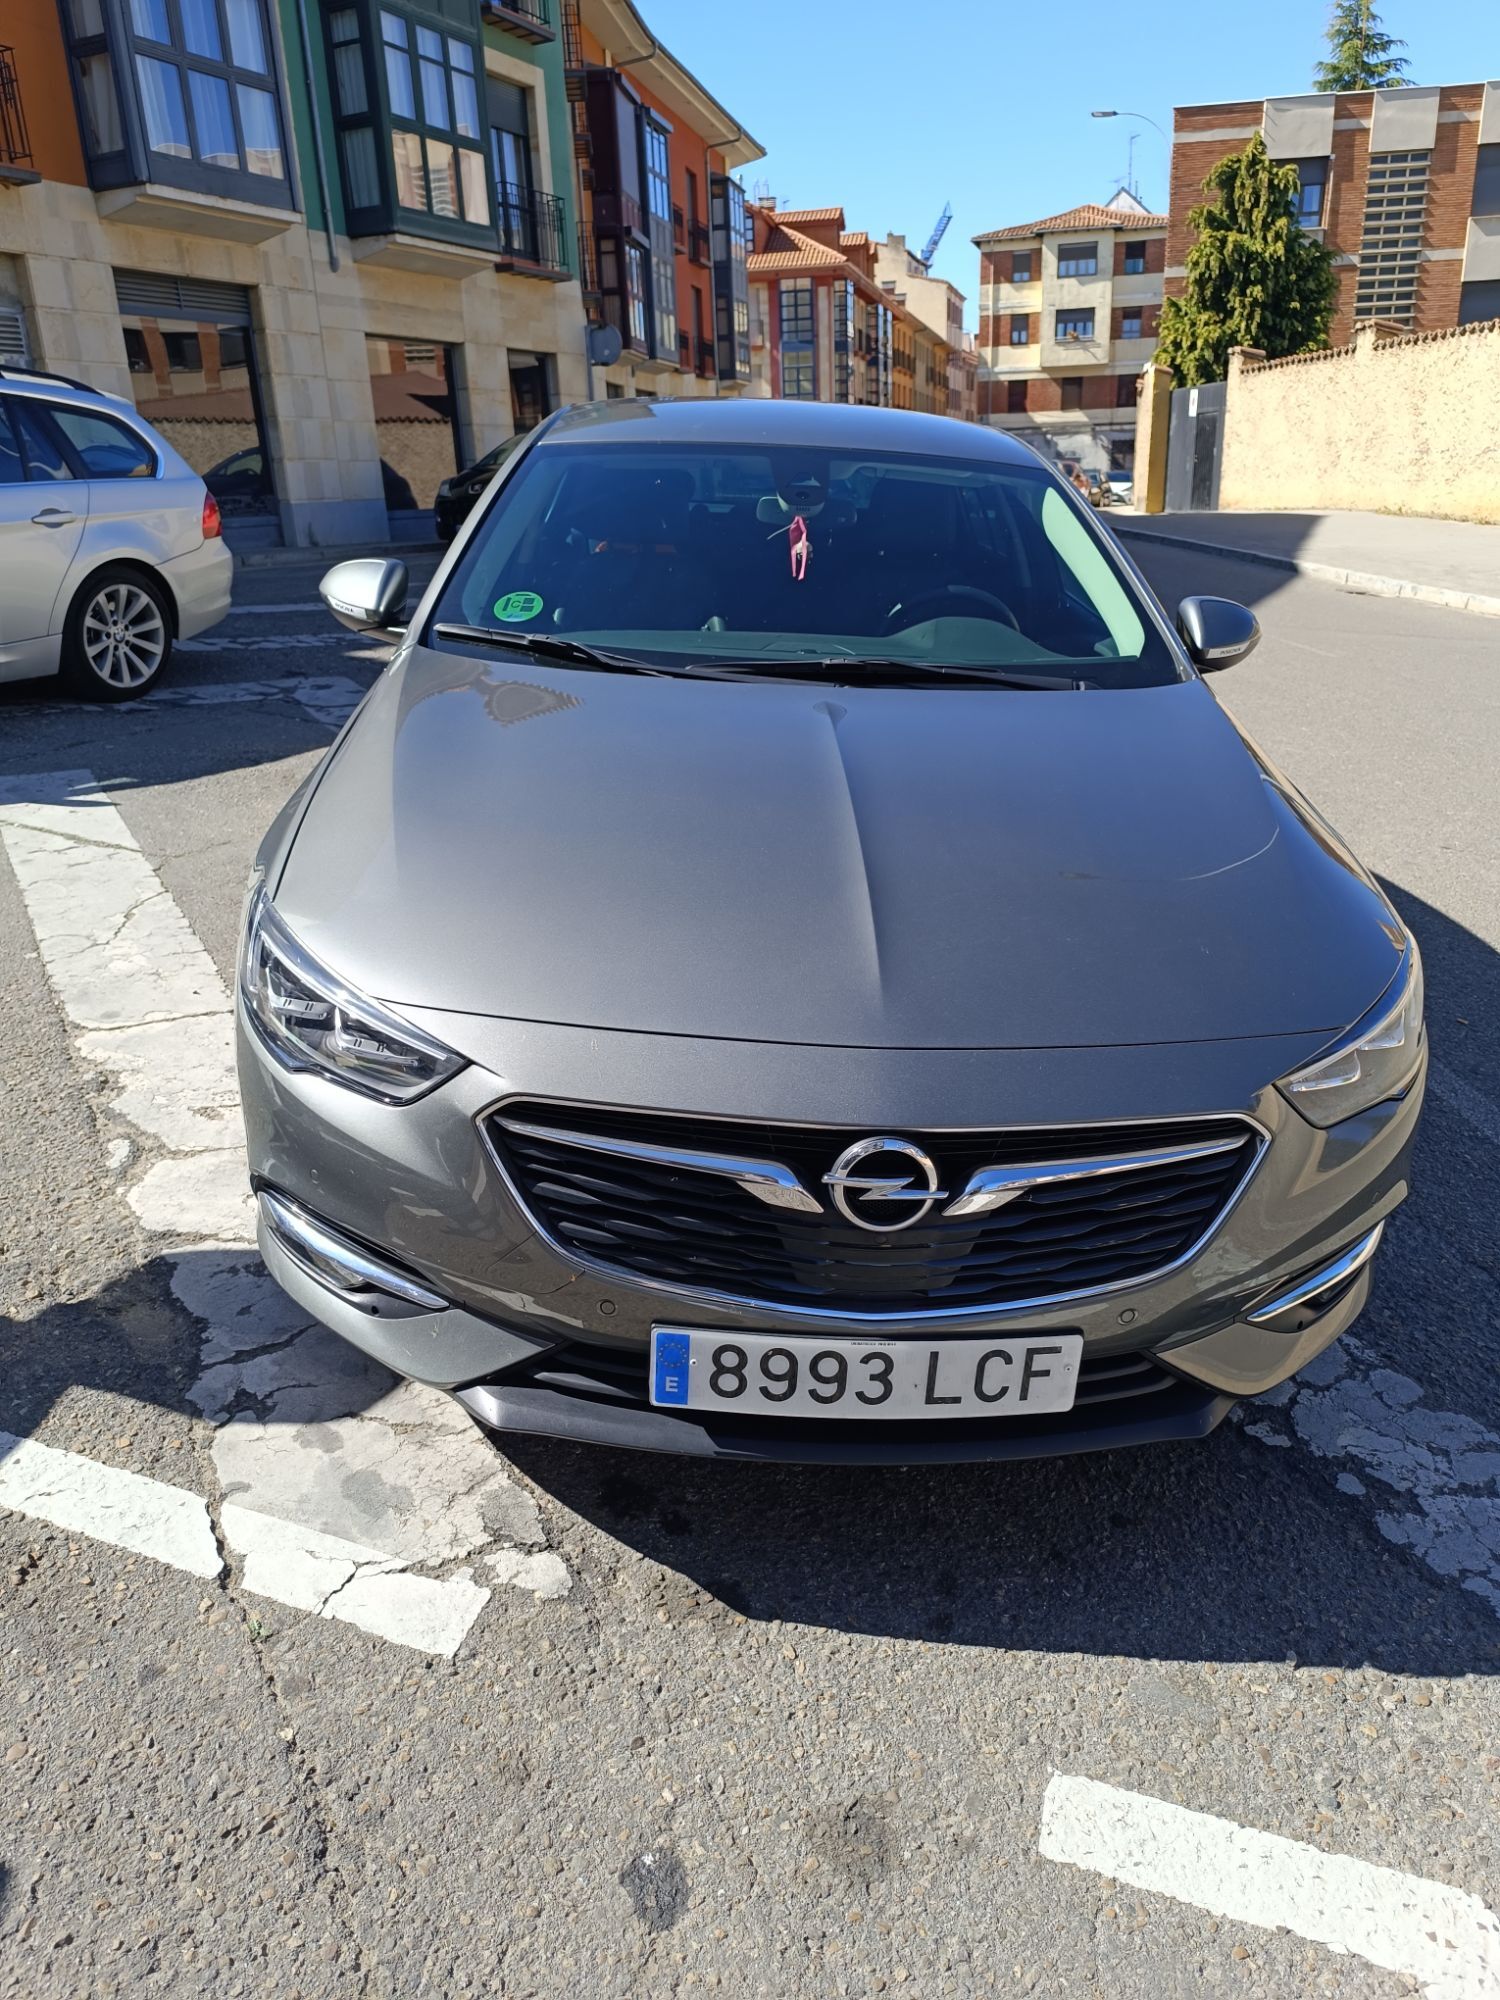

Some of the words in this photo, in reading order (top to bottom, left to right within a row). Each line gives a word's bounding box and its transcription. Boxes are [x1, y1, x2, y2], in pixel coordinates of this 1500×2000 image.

[665, 1376, 679, 1393] E
[709, 1344, 895, 1406] 8993
[924, 1345, 1063, 1406] LCF
